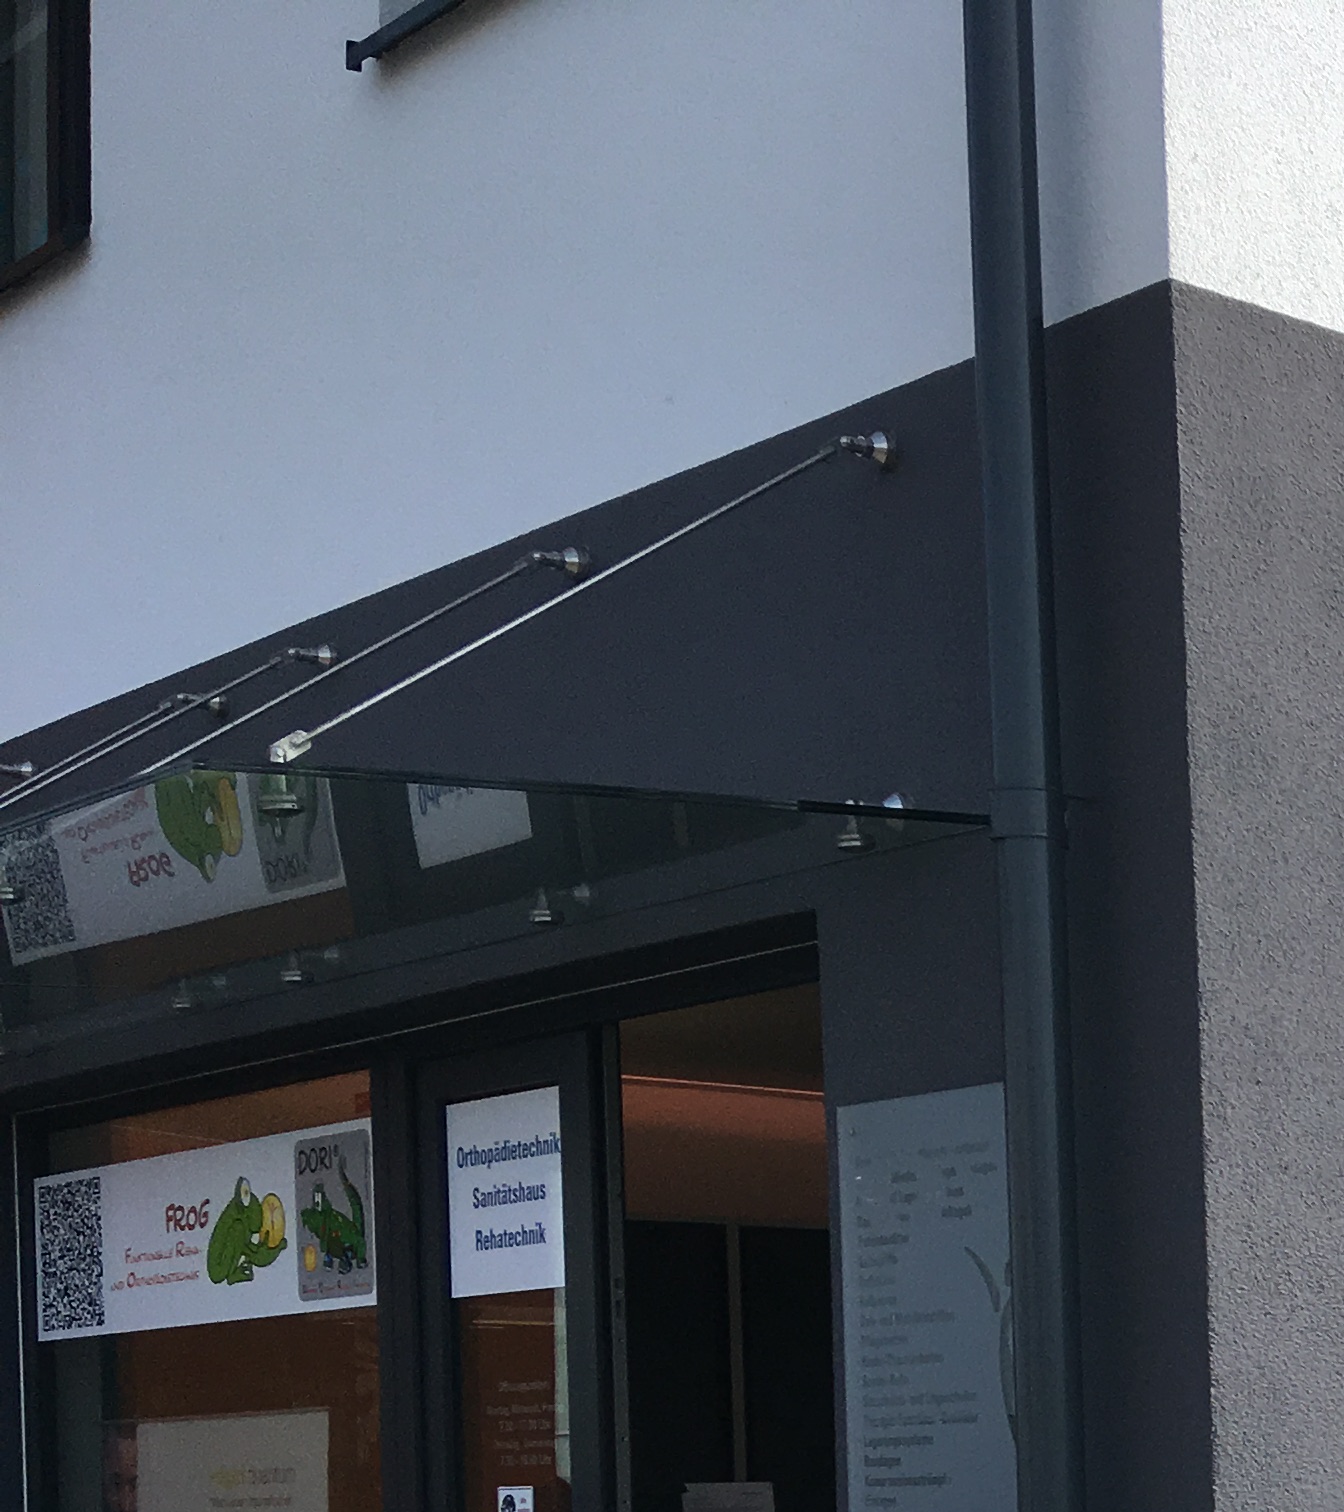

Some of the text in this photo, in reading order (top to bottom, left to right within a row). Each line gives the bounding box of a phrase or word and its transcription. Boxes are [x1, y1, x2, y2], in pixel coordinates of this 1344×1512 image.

[456, 1131, 561, 1169] Orthopädietechnik
[472, 1181, 546, 1209] Sanitätshaus
[165, 1198, 210, 1233] FROG
[475, 1221, 546, 1251] Rehatechnik
